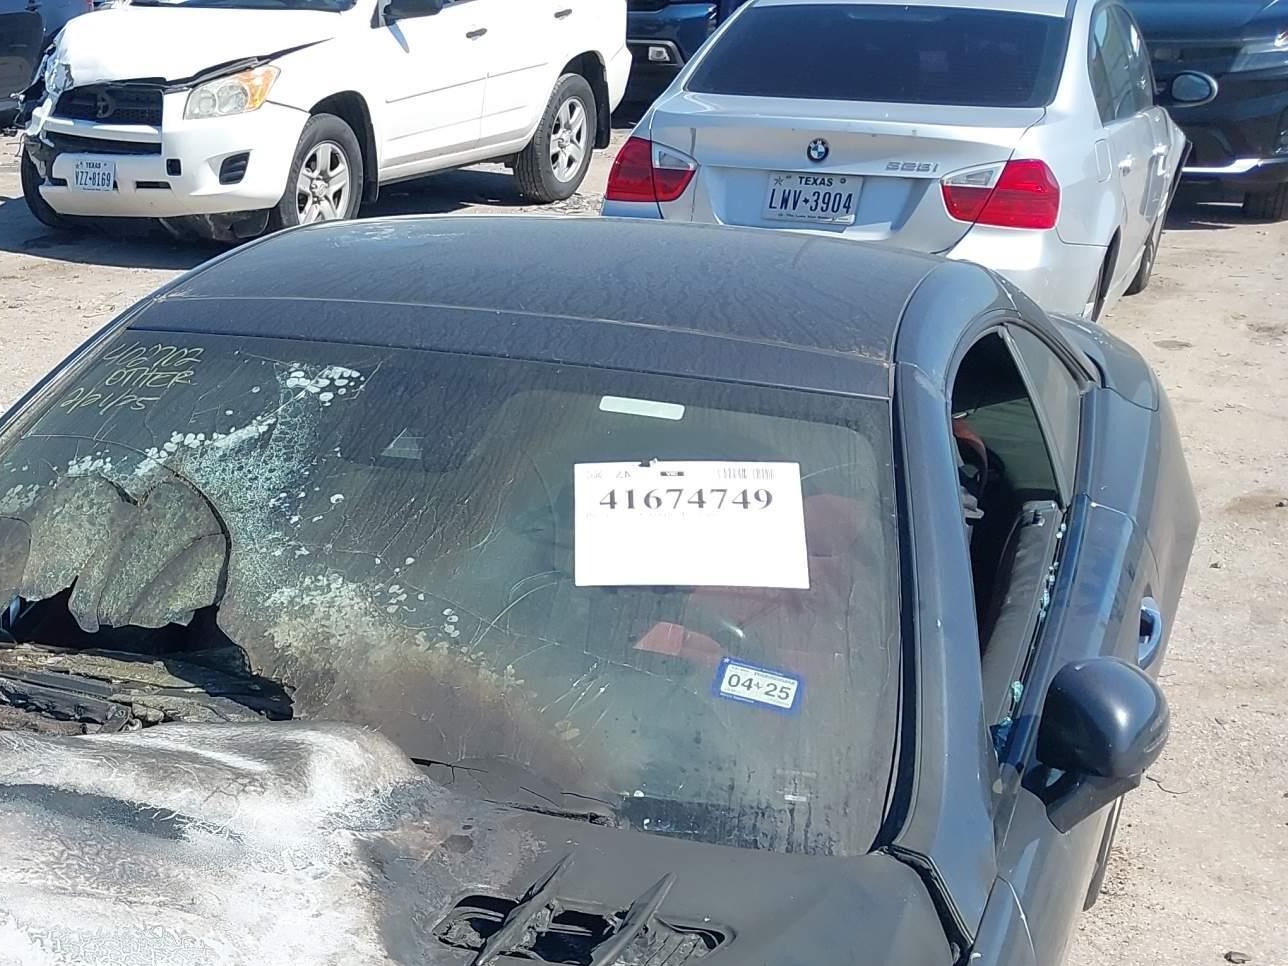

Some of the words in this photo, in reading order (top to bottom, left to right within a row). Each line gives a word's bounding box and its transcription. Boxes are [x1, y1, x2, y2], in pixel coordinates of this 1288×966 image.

[85, 161, 101, 169] TEXAS
[798, 176, 834, 187] TEXAS
[599, 488, 773, 510] 41674749
